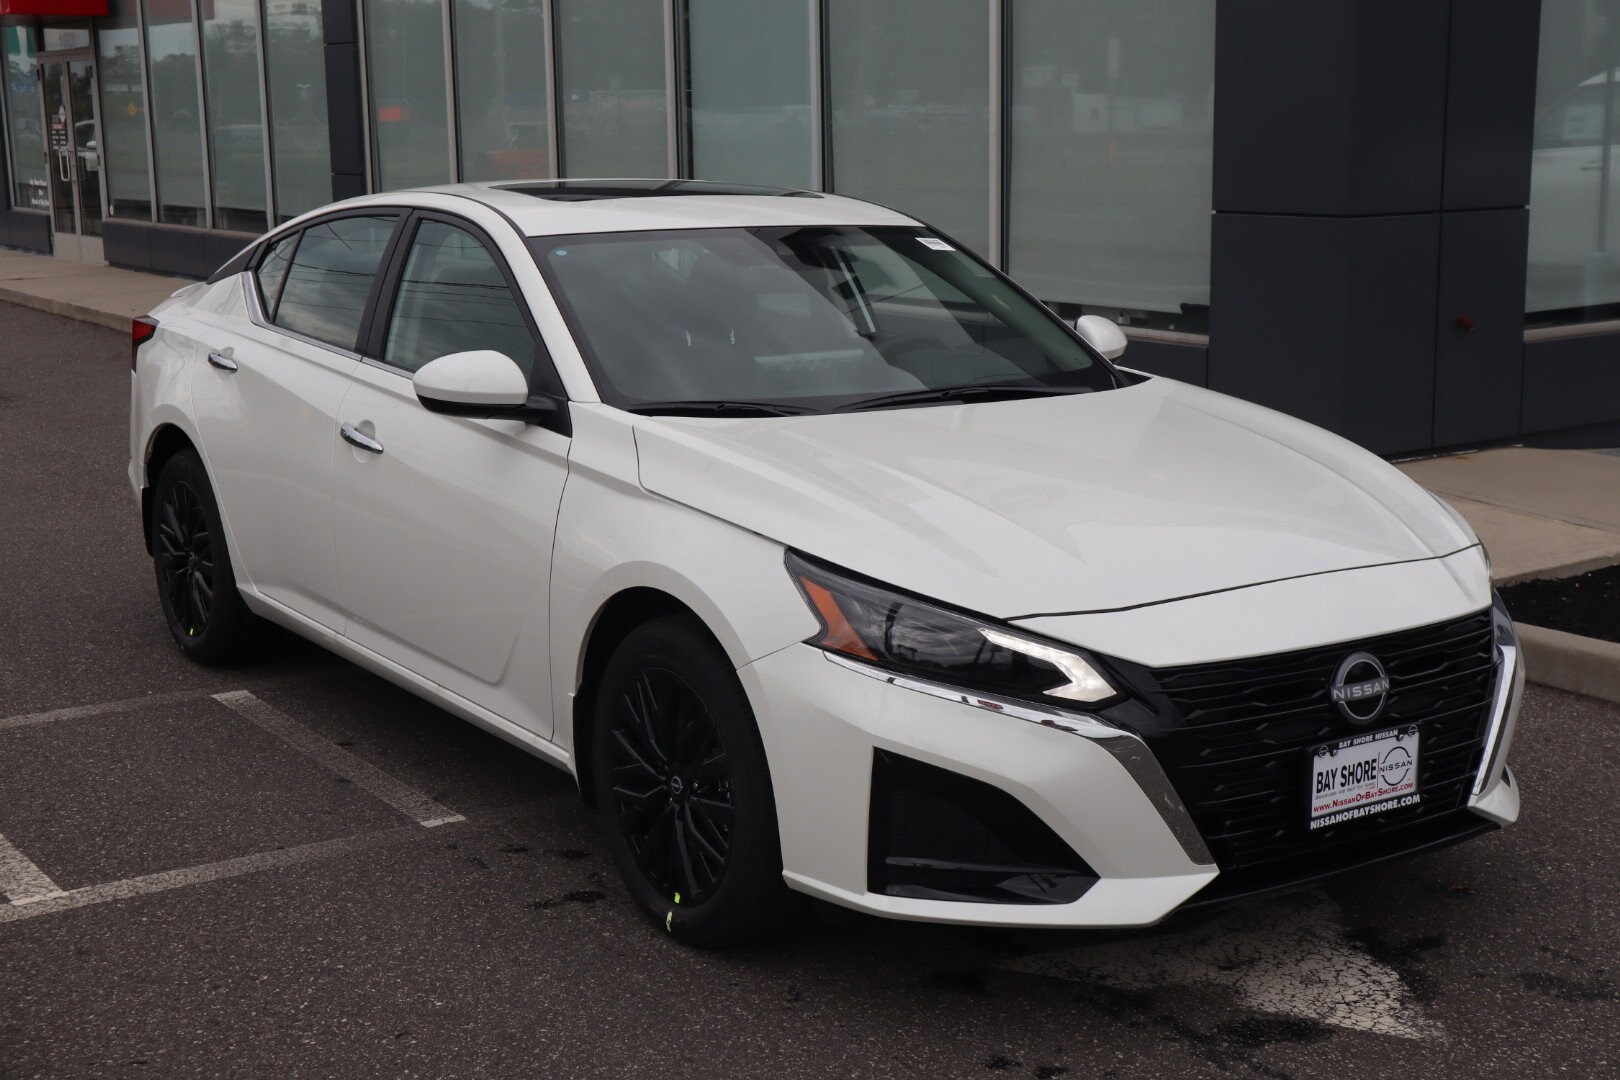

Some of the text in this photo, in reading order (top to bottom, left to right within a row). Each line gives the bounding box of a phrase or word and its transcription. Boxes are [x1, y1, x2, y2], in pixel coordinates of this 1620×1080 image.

[1333, 678, 1390, 700] NISSAN
[1338, 740, 1351, 749] BAY
[1353, 734, 1373, 745] SHORE
[1375, 729, 1399, 740] NISSAN
[1316, 758, 1377, 794] BAY SHORE
[1380, 759, 1413, 773] NISSAN
[1310, 794, 1421, 830] NISSANOFBAYSHORE.COM
